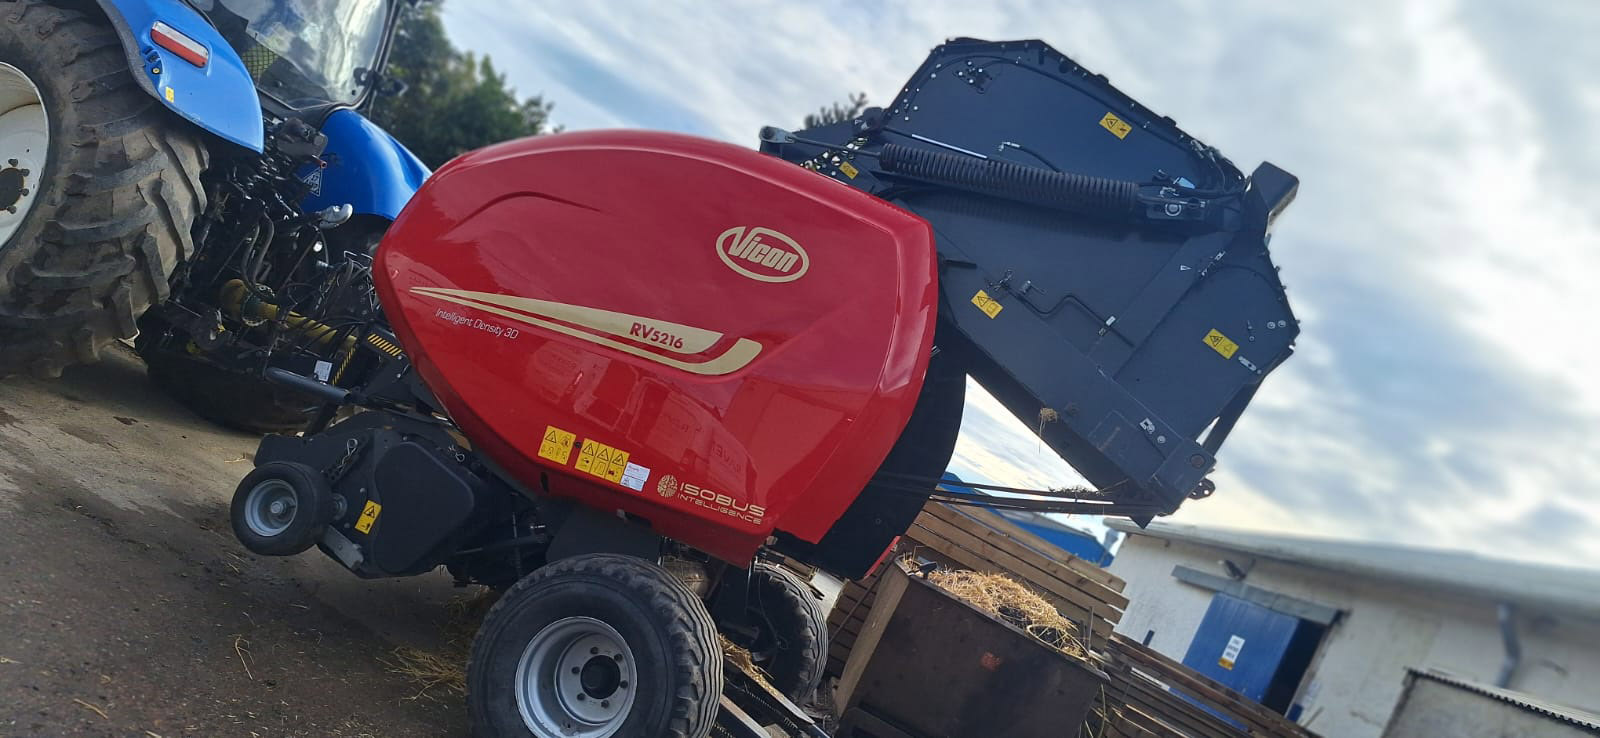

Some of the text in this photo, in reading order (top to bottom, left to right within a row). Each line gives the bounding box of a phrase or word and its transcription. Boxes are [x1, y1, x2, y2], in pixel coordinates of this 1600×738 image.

[727, 226, 799, 273] Vicon
[435, 308, 519, 339] Intelligent Density 3D
[629, 322, 684, 349] RV5216
[677, 494, 762, 525] INTELLIGENCE
[679, 482, 766, 517] ISOBUS
